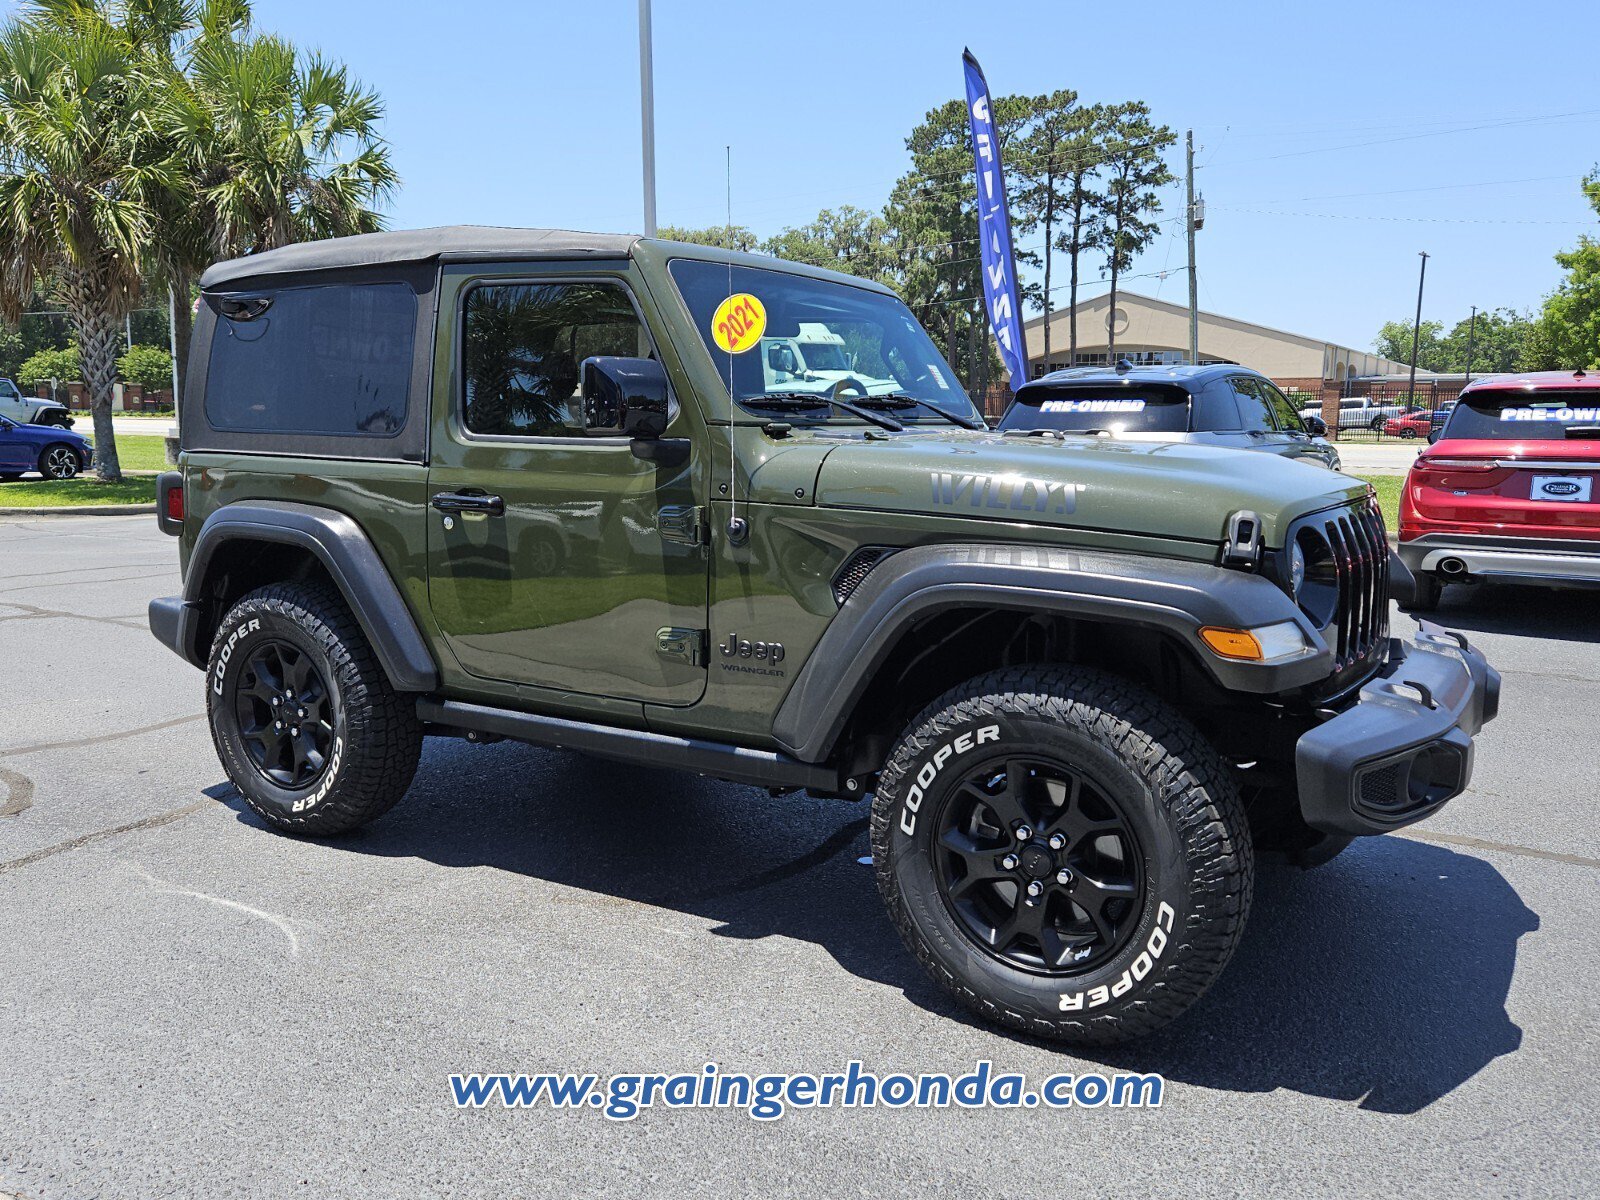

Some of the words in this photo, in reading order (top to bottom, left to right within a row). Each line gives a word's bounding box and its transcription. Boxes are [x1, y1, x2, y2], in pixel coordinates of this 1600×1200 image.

[718, 297, 760, 349] 2021
[1039, 400, 1146, 413] PRE-OWNED
[1500, 408, 1600, 421] PRE-OW
[931, 472, 1086, 515] WILLYS
[213, 618, 261, 696] COOPER
[719, 632, 785, 667] Jeep
[720, 662, 785, 678] WRANGLER
[291, 736, 344, 813] COOPER
[899, 723, 1001, 836] COOPER
[1058, 901, 1175, 1012] COOPER
